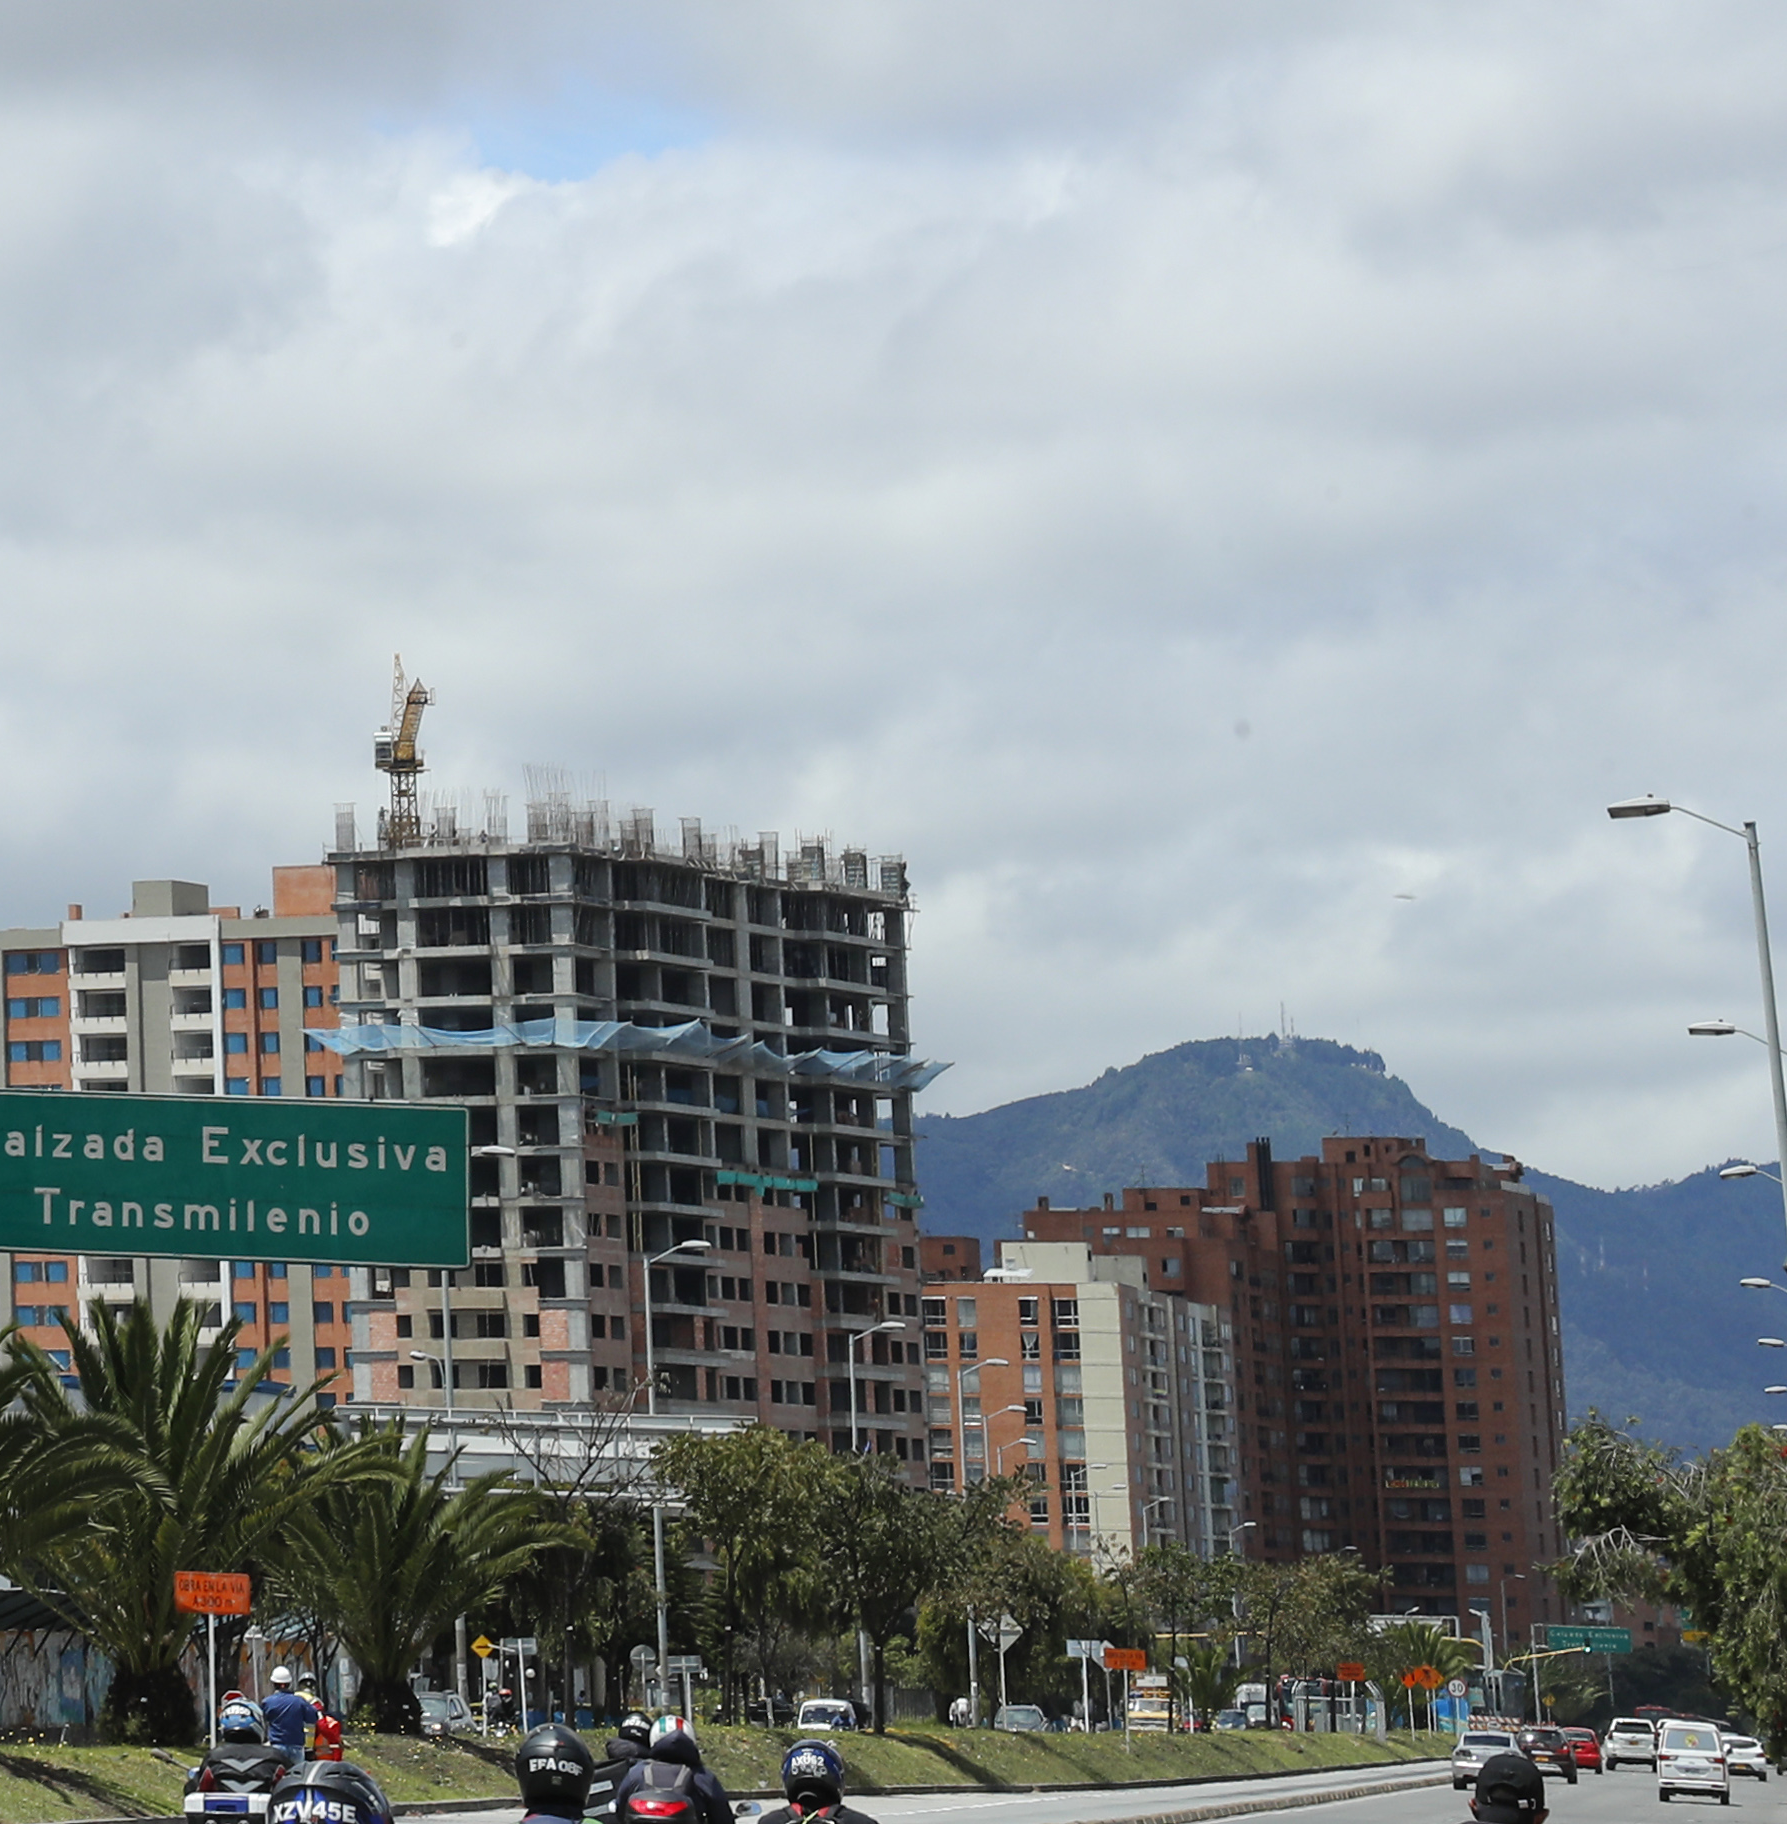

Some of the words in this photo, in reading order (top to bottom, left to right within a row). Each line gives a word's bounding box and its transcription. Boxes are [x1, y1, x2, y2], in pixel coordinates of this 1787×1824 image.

[202, 1126, 447, 1172] Exclusiva
[34, 1187, 370, 1236] Transmilenio
[1450, 1683, 1463, 1694] 30
